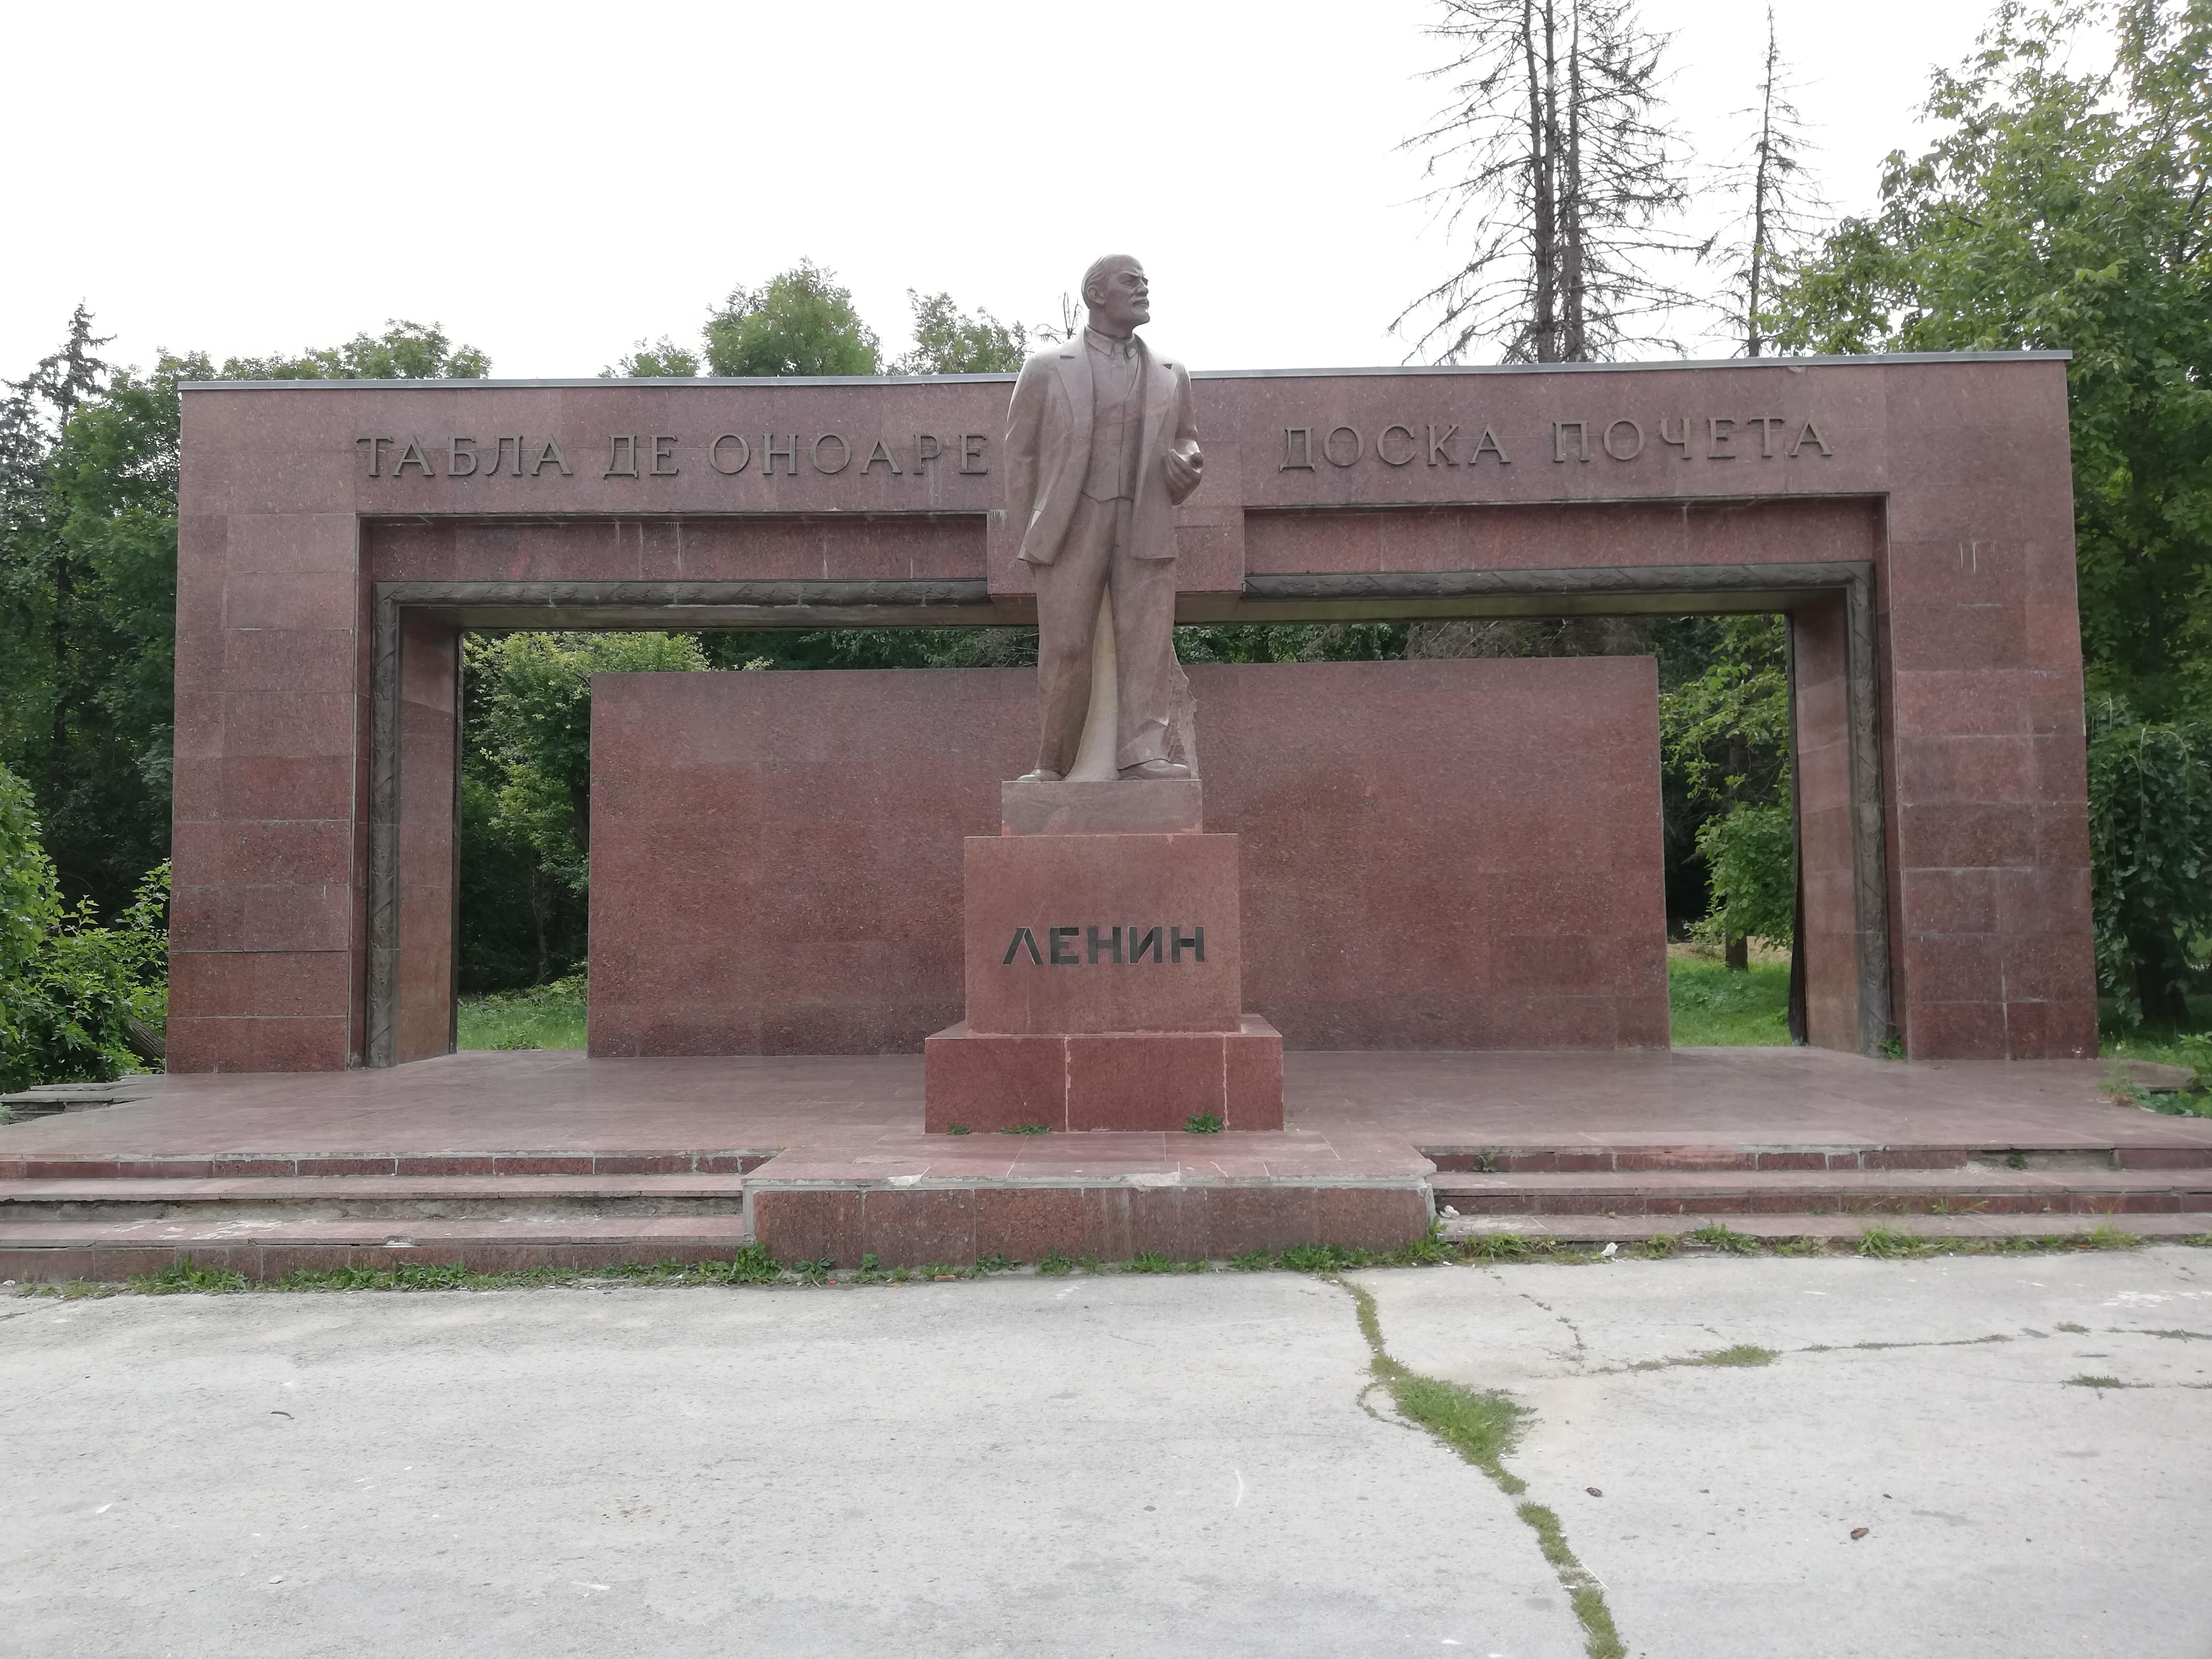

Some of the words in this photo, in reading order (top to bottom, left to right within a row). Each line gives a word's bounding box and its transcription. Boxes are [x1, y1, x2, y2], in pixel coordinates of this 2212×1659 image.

[356, 434, 573, 477] ТАБЛА
[601, 434, 679, 480] ДЕ
[709, 433, 988, 475] ОНОАРЕ
[1279, 423, 1512, 472] ДОСКА
[1553, 417, 1833, 462] ПОЧЕТА
[1002, 925, 1205, 965] ЛЕНИН
